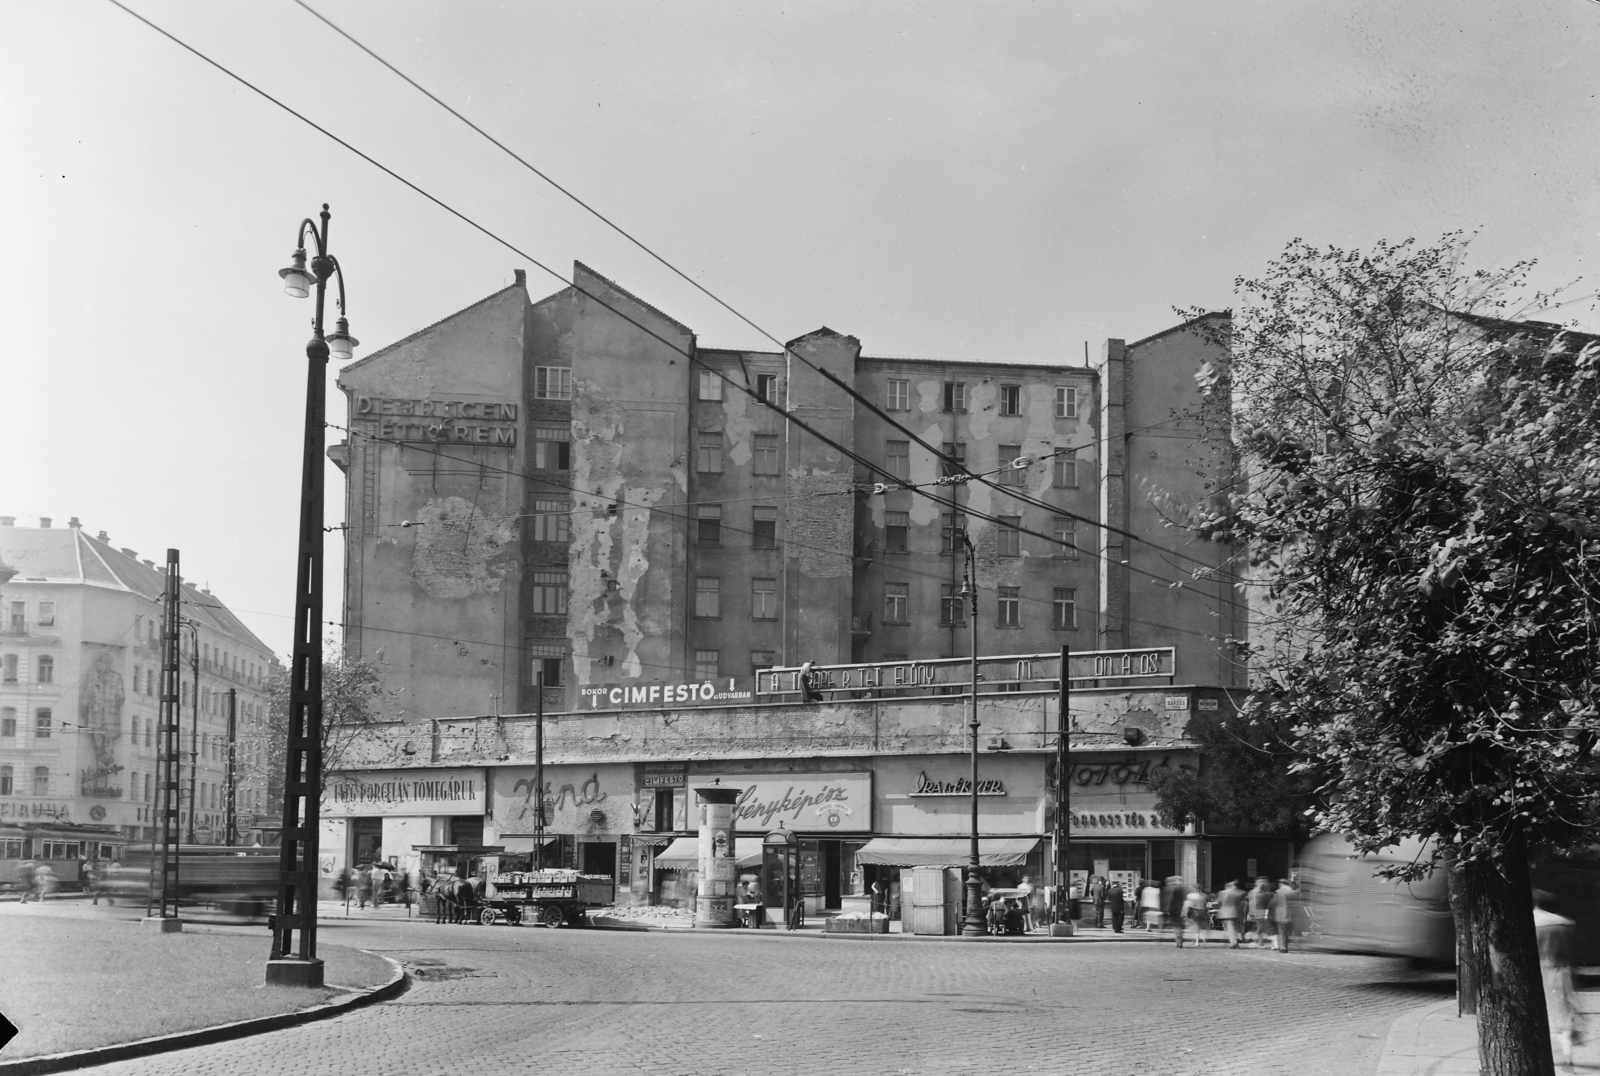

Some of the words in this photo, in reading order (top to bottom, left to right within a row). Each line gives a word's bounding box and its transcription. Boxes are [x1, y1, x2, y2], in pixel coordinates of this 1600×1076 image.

[771, 673, 778, 691] A
[581, 688, 608, 696] BOKOR
[609, 680, 715, 704] CIMFESTŐ
[718, 691, 751, 699] UDVARBAN
[953, 777, 1002, 793] ÉKZER
[1072, 814, 1123, 826] BAROSS
[1124, 811, 1147, 827] TÉR
